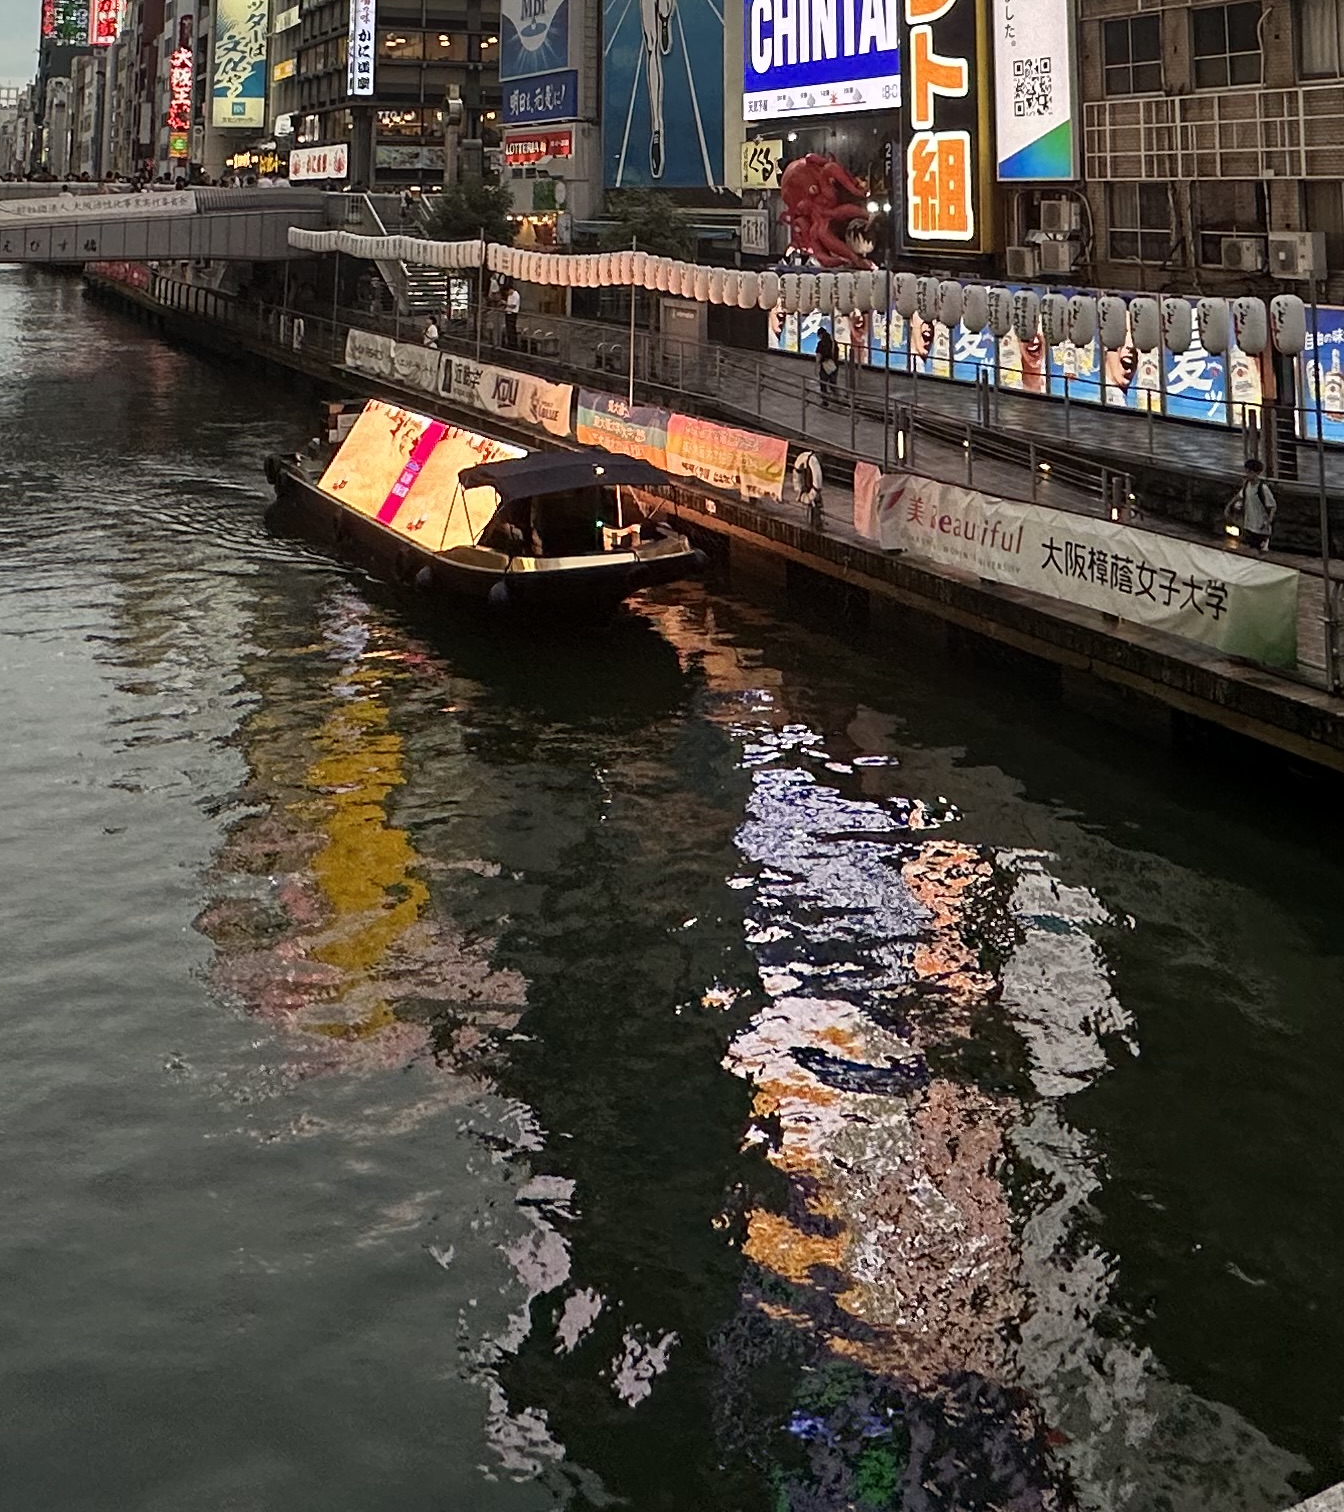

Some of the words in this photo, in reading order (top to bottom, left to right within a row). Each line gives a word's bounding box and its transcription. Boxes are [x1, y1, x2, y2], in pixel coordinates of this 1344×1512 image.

[906, 496, 924, 527] 美
[1041, 536, 1229, 621] 大阪樟蔭女子大学
